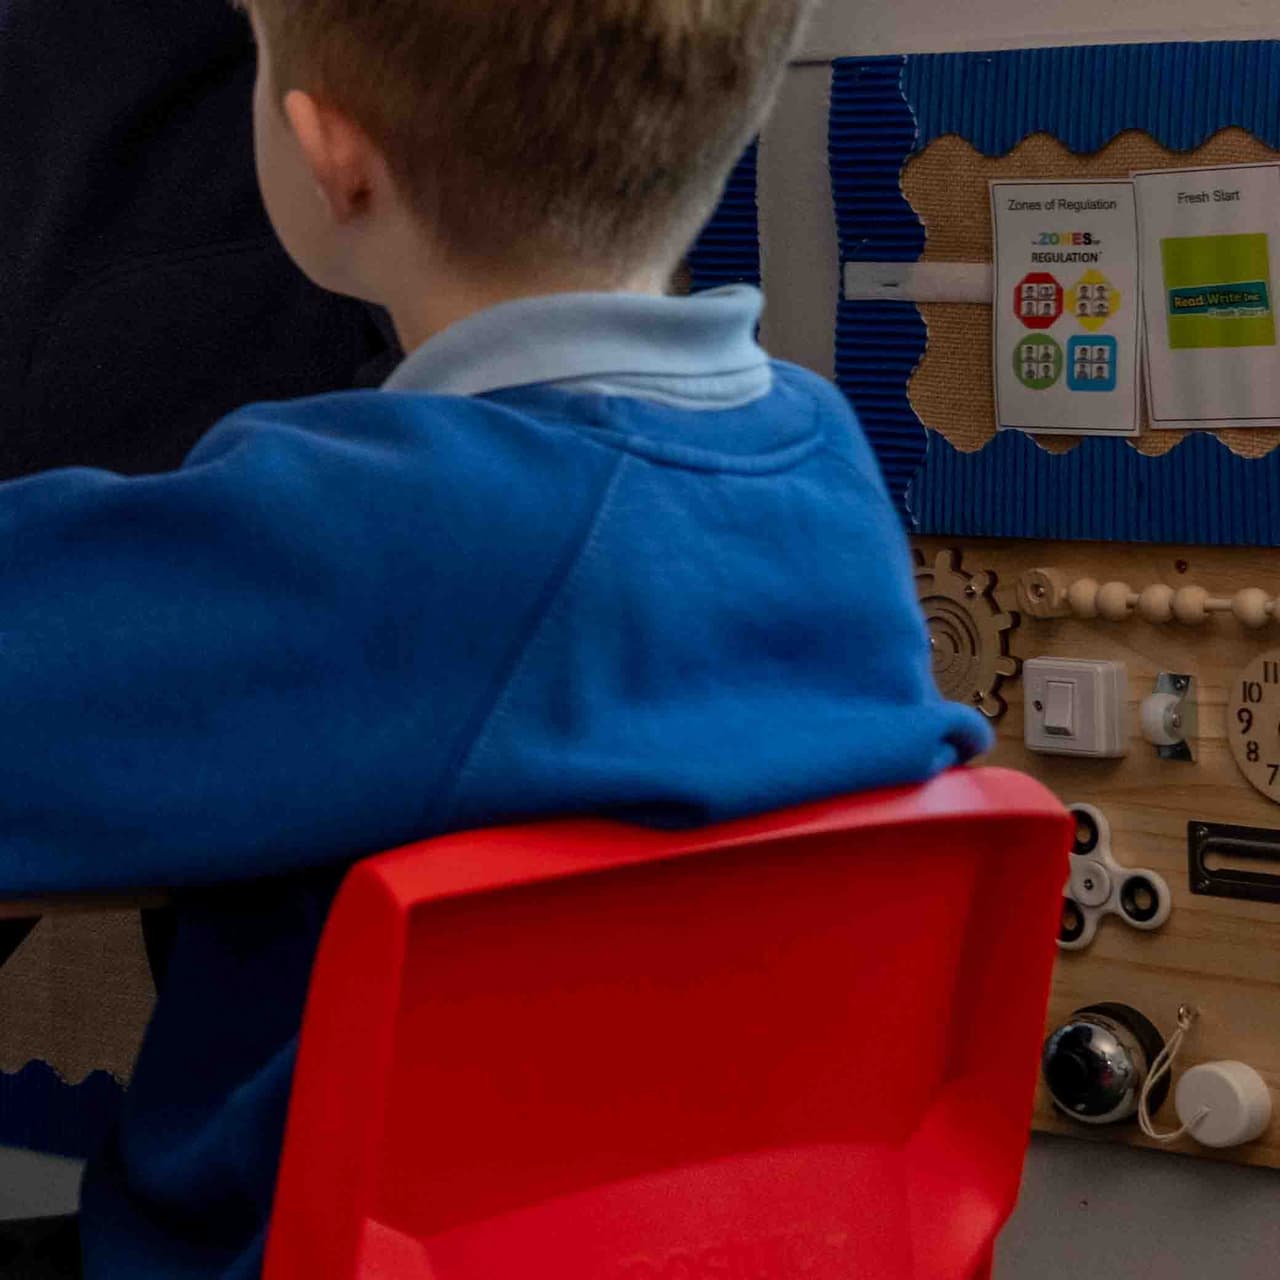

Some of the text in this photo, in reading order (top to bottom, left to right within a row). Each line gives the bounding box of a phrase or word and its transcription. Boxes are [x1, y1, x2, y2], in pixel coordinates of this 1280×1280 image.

[1177, 189, 1241, 205] Fresh Start
[1007, 199, 1117, 213] Zones of Regulation
[1031, 251, 1099, 263] REGULATION
[1173, 294, 1205, 309] Read
